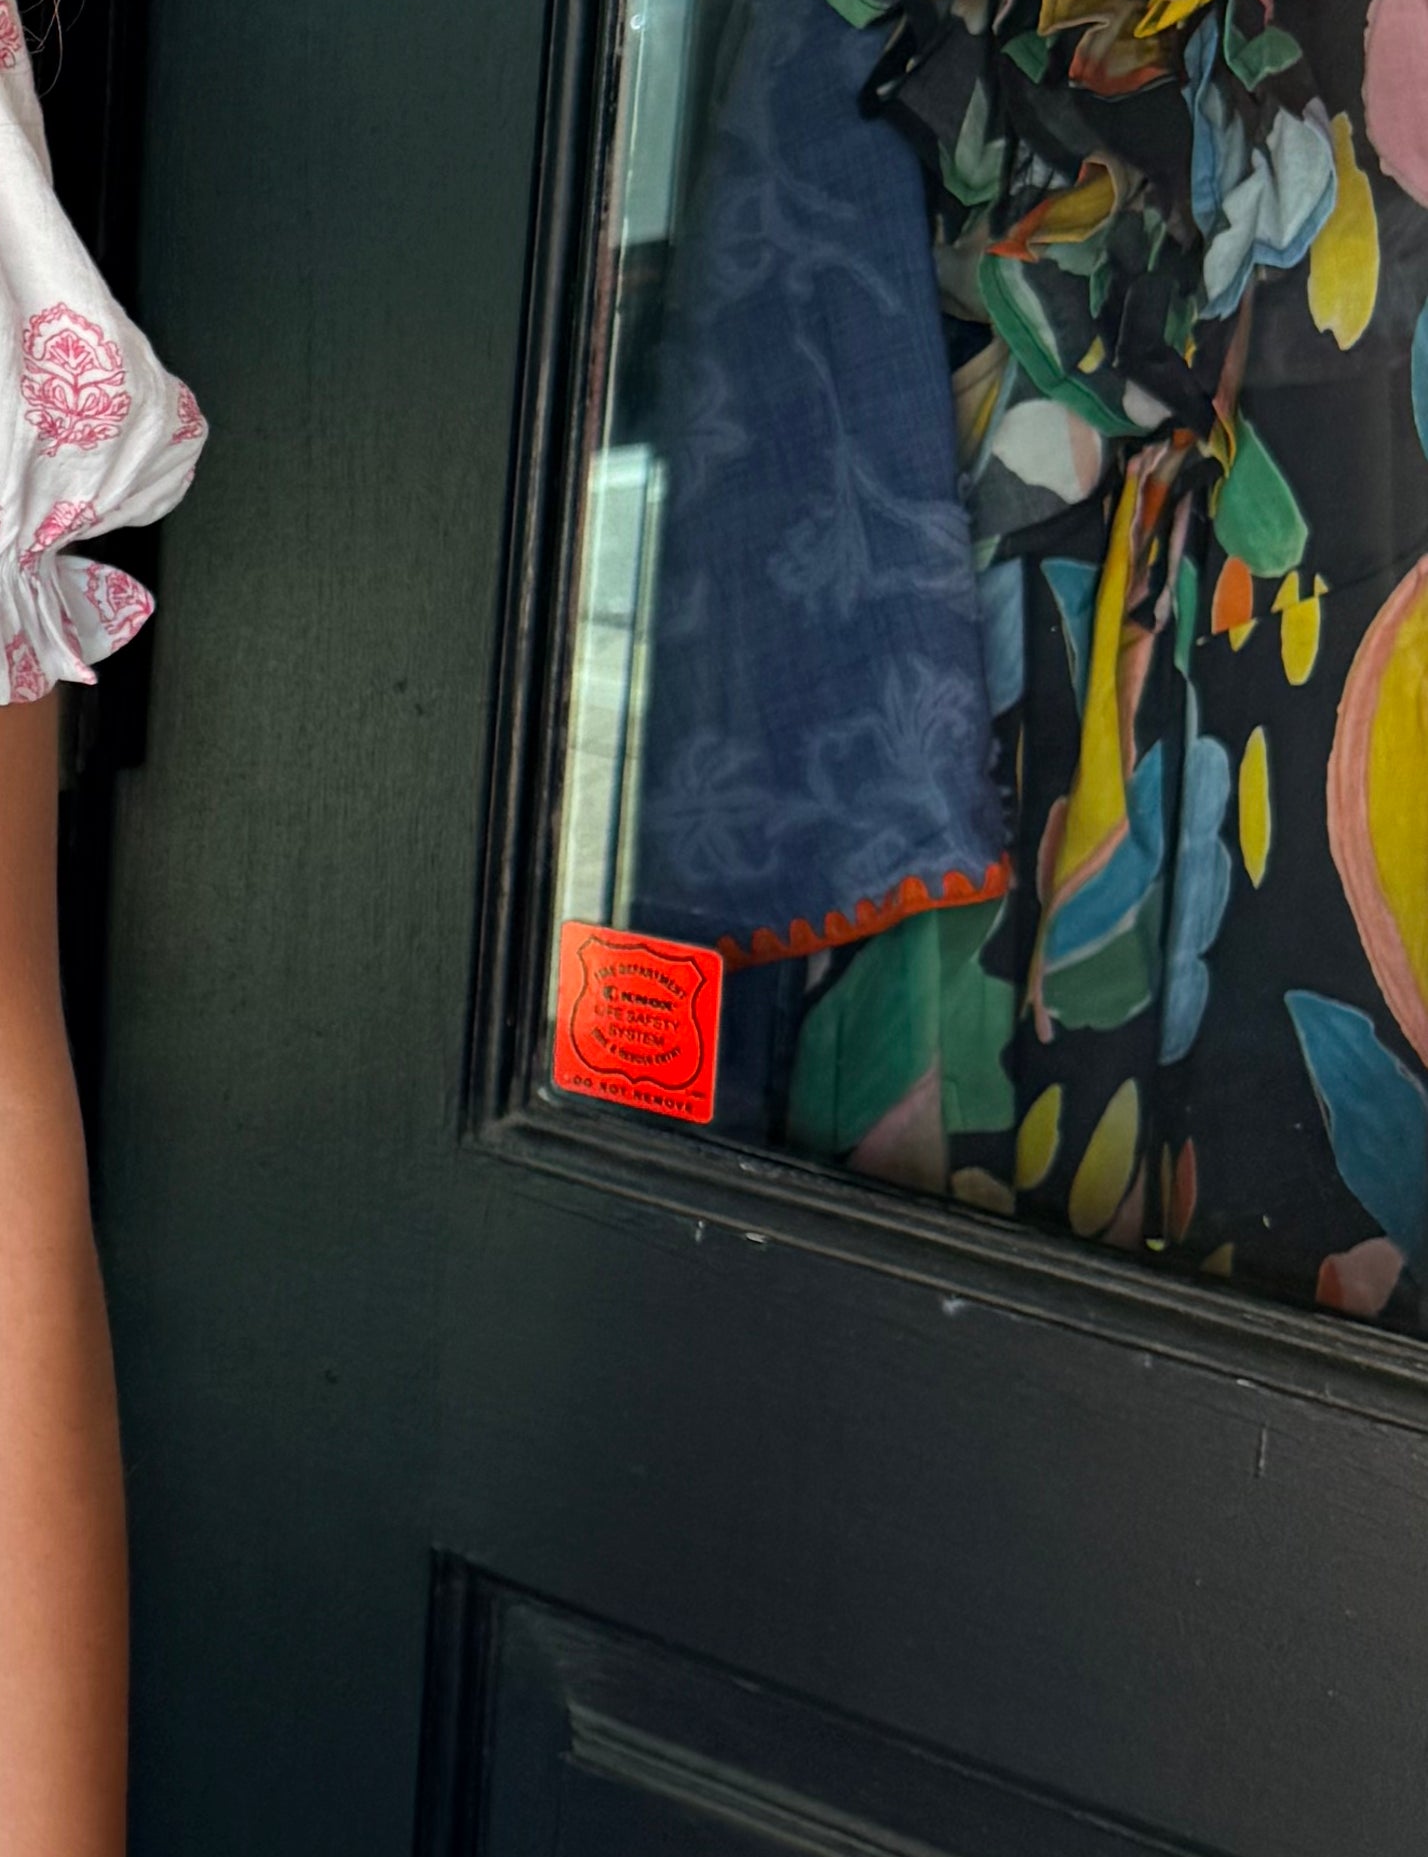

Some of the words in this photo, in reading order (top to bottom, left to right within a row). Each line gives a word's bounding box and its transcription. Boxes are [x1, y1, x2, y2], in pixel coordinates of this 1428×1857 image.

[619, 964, 685, 999] DEPARTMENT
[594, 1004, 623, 1022] LIFE
[627, 1010, 680, 1031] SAFETY
[609, 1023, 664, 1046] SYSTEM
[573, 1074, 593, 1088] DO
[599, 1081, 626, 1095] NOT
[633, 1090, 693, 1113] REMOVE
